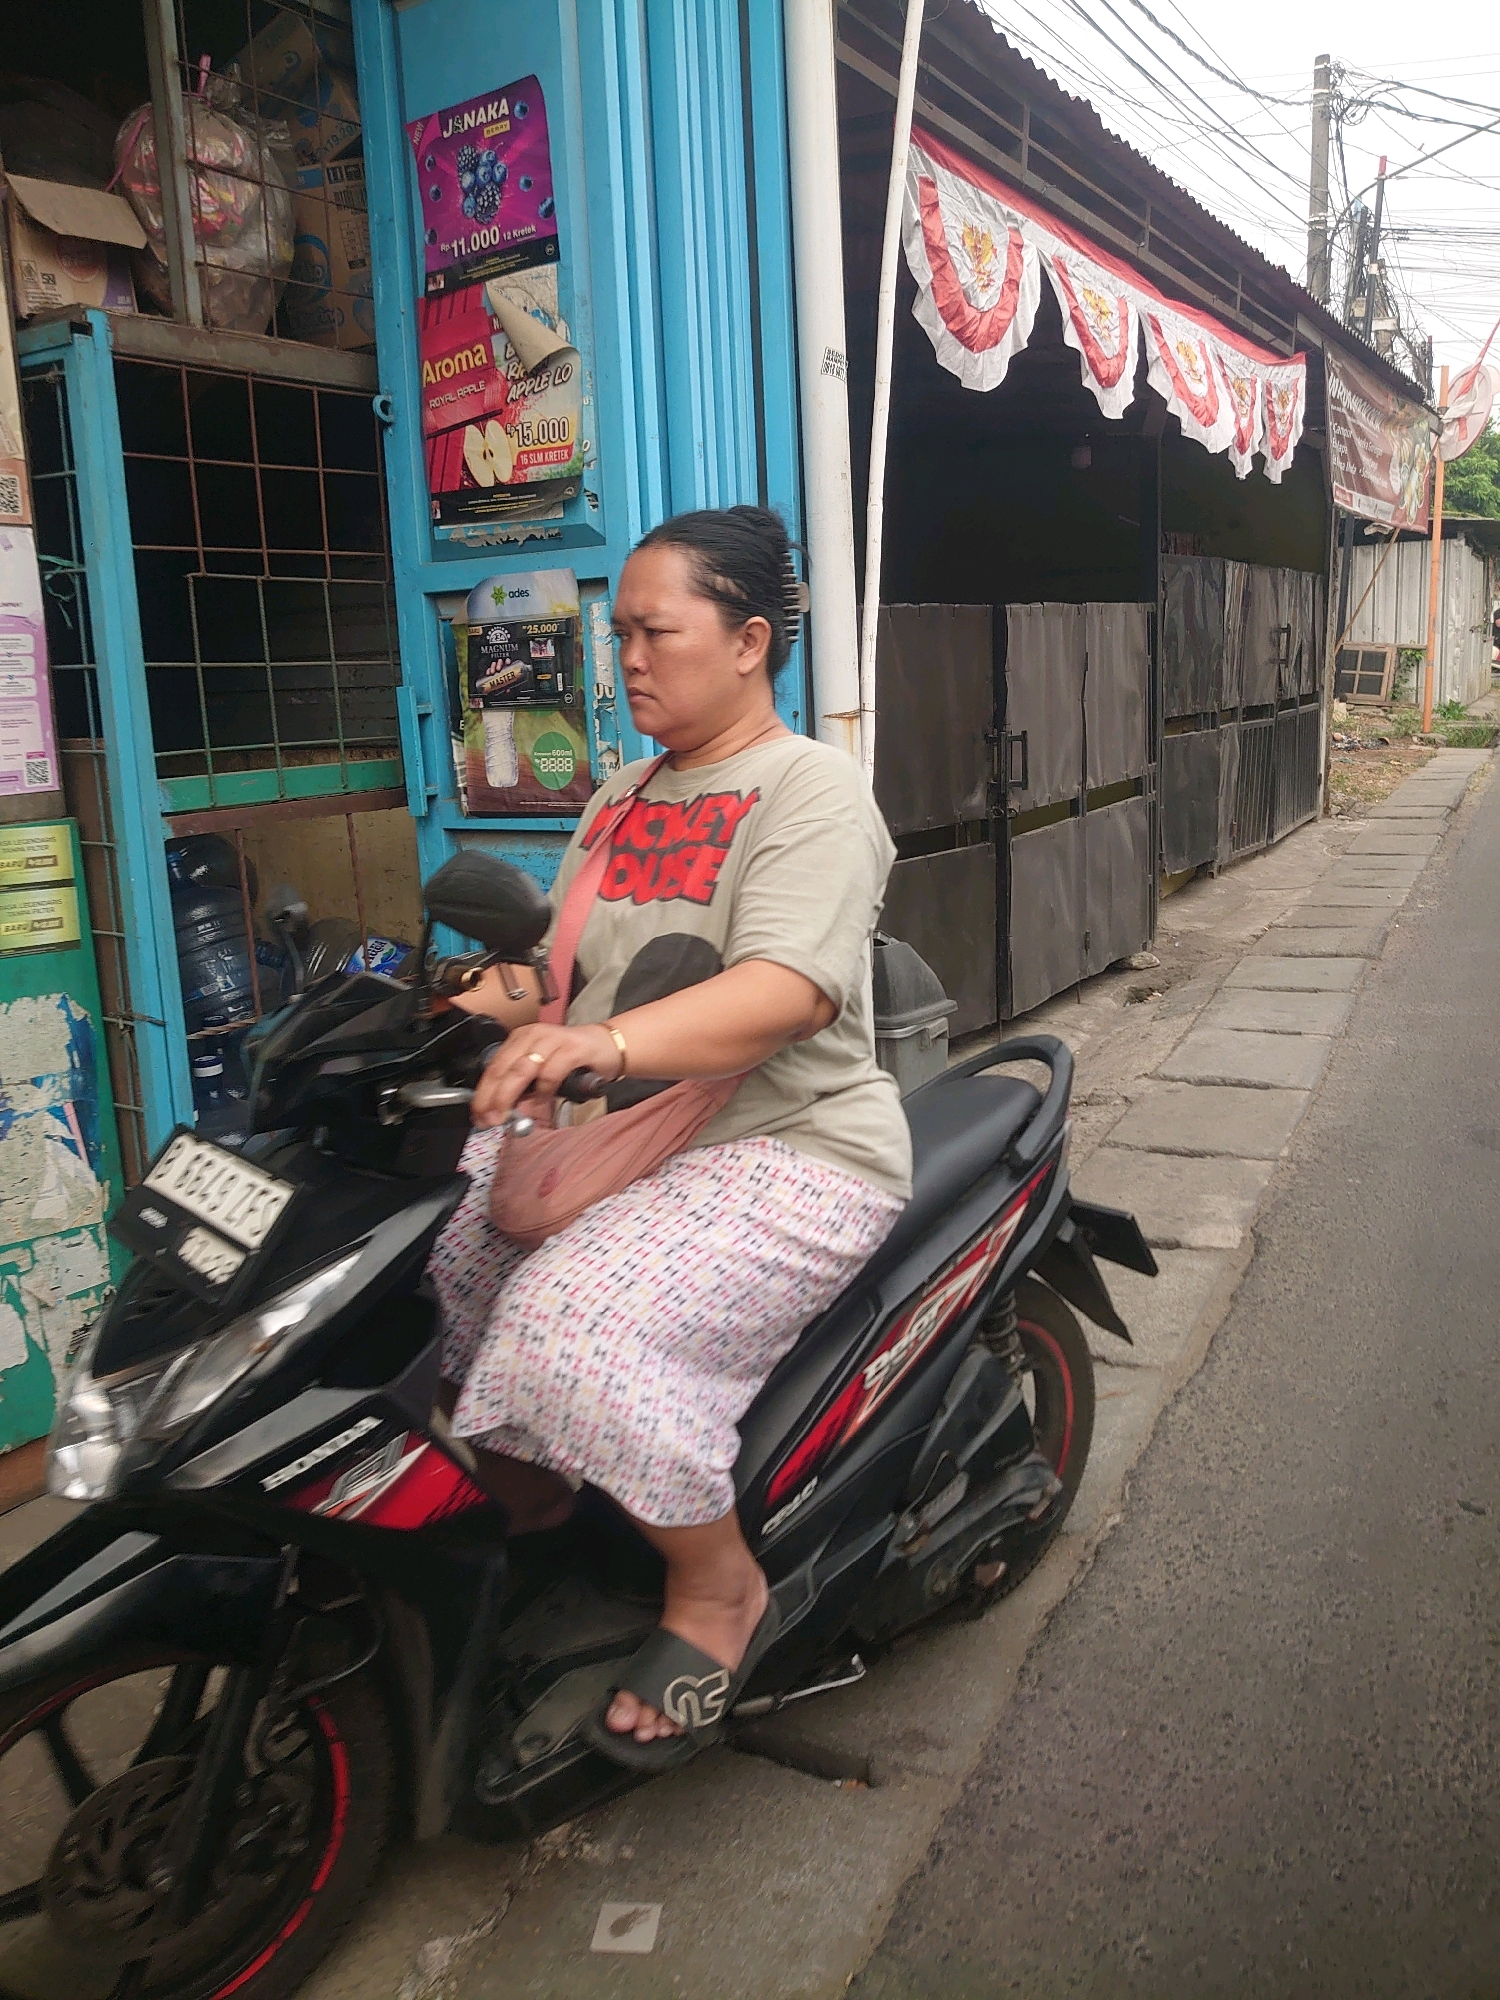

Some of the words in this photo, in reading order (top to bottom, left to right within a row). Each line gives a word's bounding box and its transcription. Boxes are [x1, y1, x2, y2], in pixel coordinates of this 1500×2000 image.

[413, 121, 425, 146] NEW
[503, 229, 511, 241] 12
[423, 343, 488, 388] Aroma
[429, 393, 457, 410] ROYAL
[457, 380, 486, 398] APPLE
[506, 371, 551, 404] APPLE
[516, 416, 569, 447] 15.000
[520, 454, 528, 465] 16
[529, 451, 543, 464] SLM
[544, 448, 569, 462] KRETEK
[508, 587, 530, 599] ades
[527, 623, 558, 634] 25.000
[492, 633, 505, 642] 234
[481, 643, 519, 654] MAGNUM
[489, 671, 516, 689] MASTER
[552, 749, 572, 757] 600ml
[598, 844, 729, 906] OUSE
